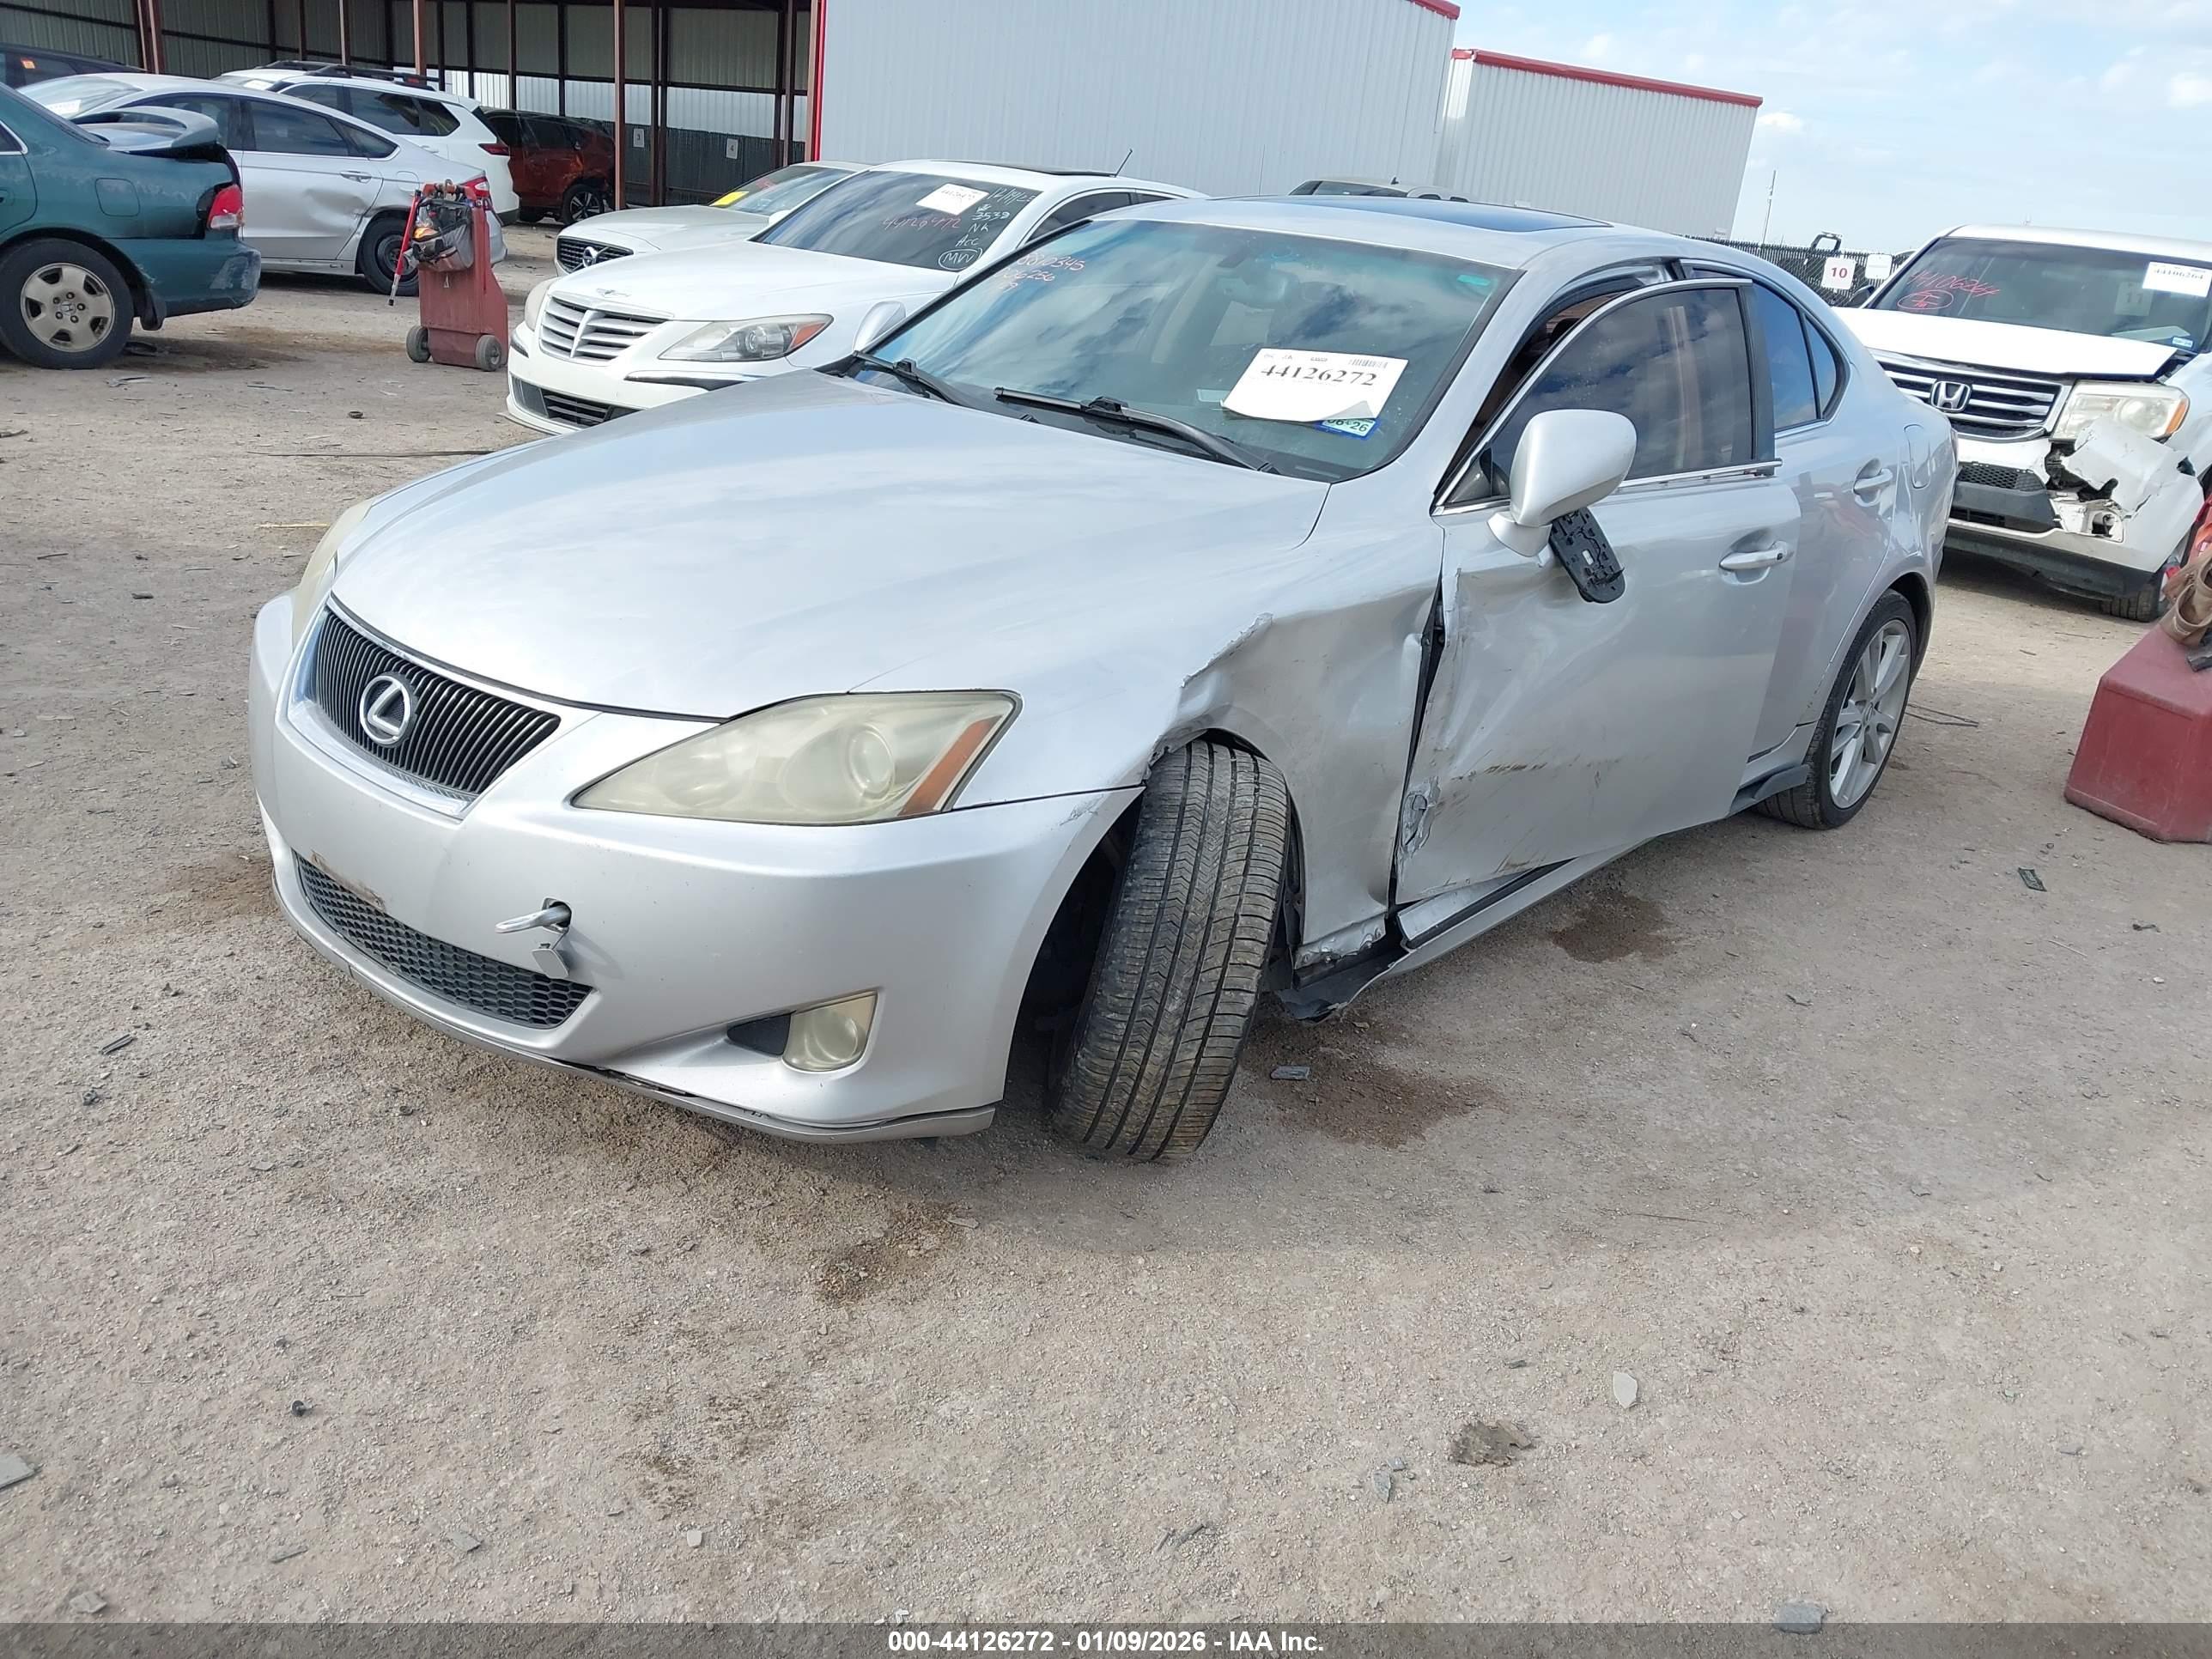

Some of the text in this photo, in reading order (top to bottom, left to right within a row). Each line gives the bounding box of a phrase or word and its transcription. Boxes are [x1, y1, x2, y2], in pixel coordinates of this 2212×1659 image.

[1831, 267, 1848, 278] 10
[1261, 364, 1377, 386] 44126272
[1350, 421, 1369, 432] 26
